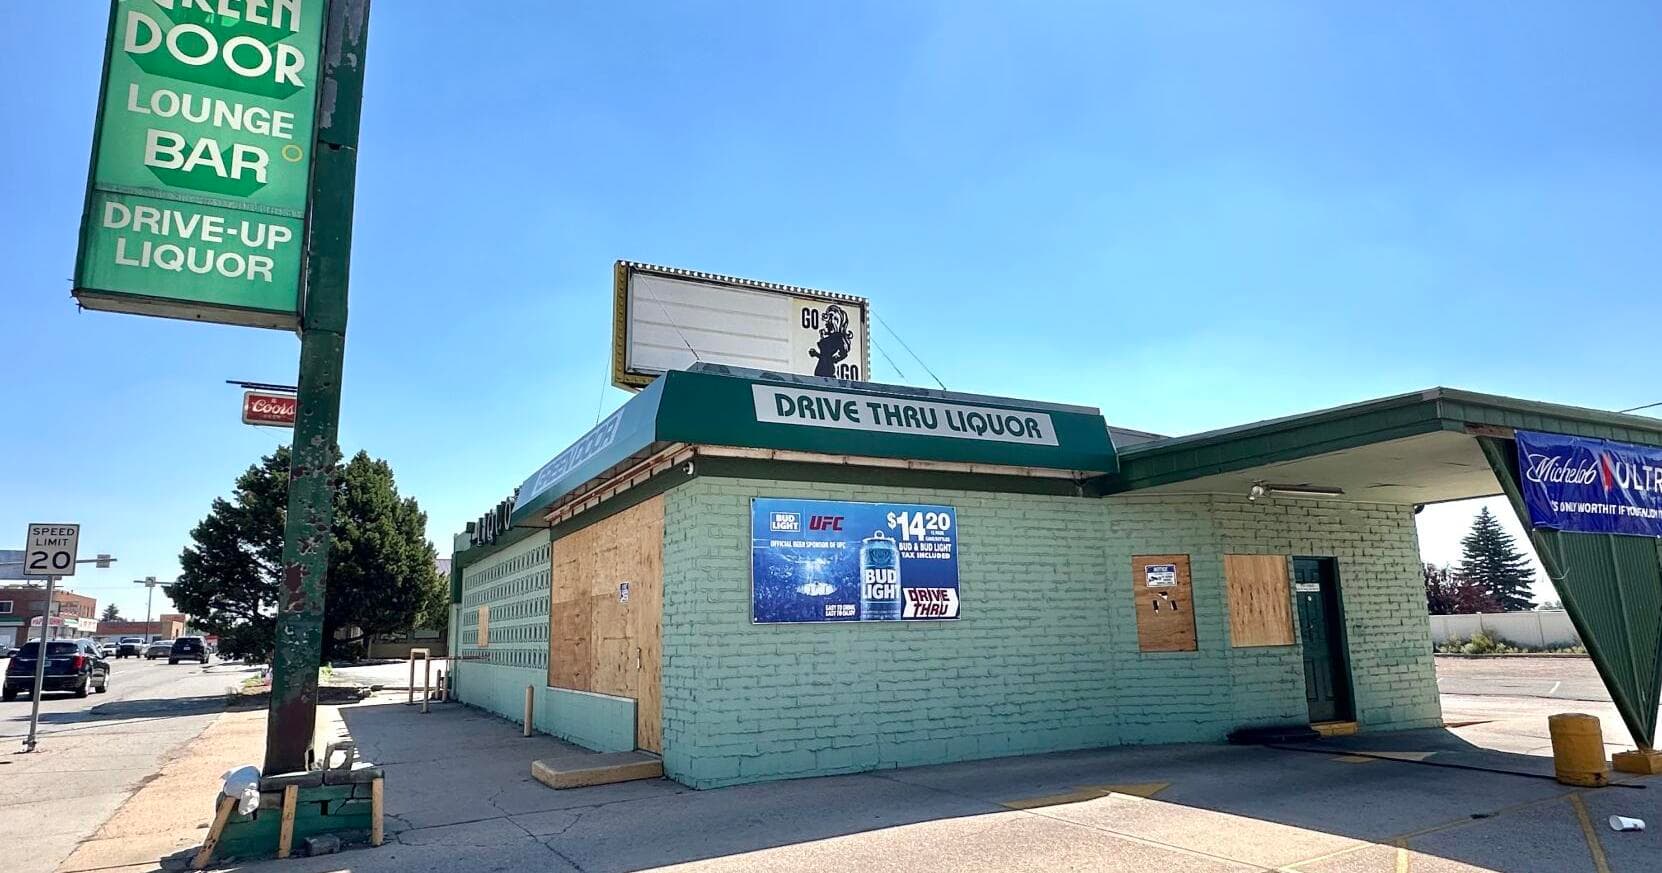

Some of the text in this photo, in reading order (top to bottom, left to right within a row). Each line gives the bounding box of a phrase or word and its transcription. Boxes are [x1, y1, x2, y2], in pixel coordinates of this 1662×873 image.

[124, 11, 305, 87] DOOR
[127, 83, 295, 140] LOUNGE
[144, 128, 268, 183] BAR
[103, 201, 292, 250] DRIVE-UP
[115, 237, 274, 282] LIQUOR
[802, 308, 819, 329] GO
[252, 399, 295, 416] Coors
[775, 393, 1042, 439] DRIVE THRU LIQUOR
[1526, 453, 1599, 485] Michelob
[1577, 502, 1608, 514] WORTH
[772, 522, 799, 530] LIGHT
[775, 514, 845, 531] BUD UFC
[32, 527, 75, 536] SPEED
[35, 537, 69, 546] LIMIT
[898, 542, 952, 553] BUD & BUD LIGHT
[30, 551, 71, 569] 20
[916, 552, 951, 560] INCLUDED
[865, 569, 897, 584] BUD
[907, 589, 950, 602] DRIVE
[914, 603, 948, 616] THRU
